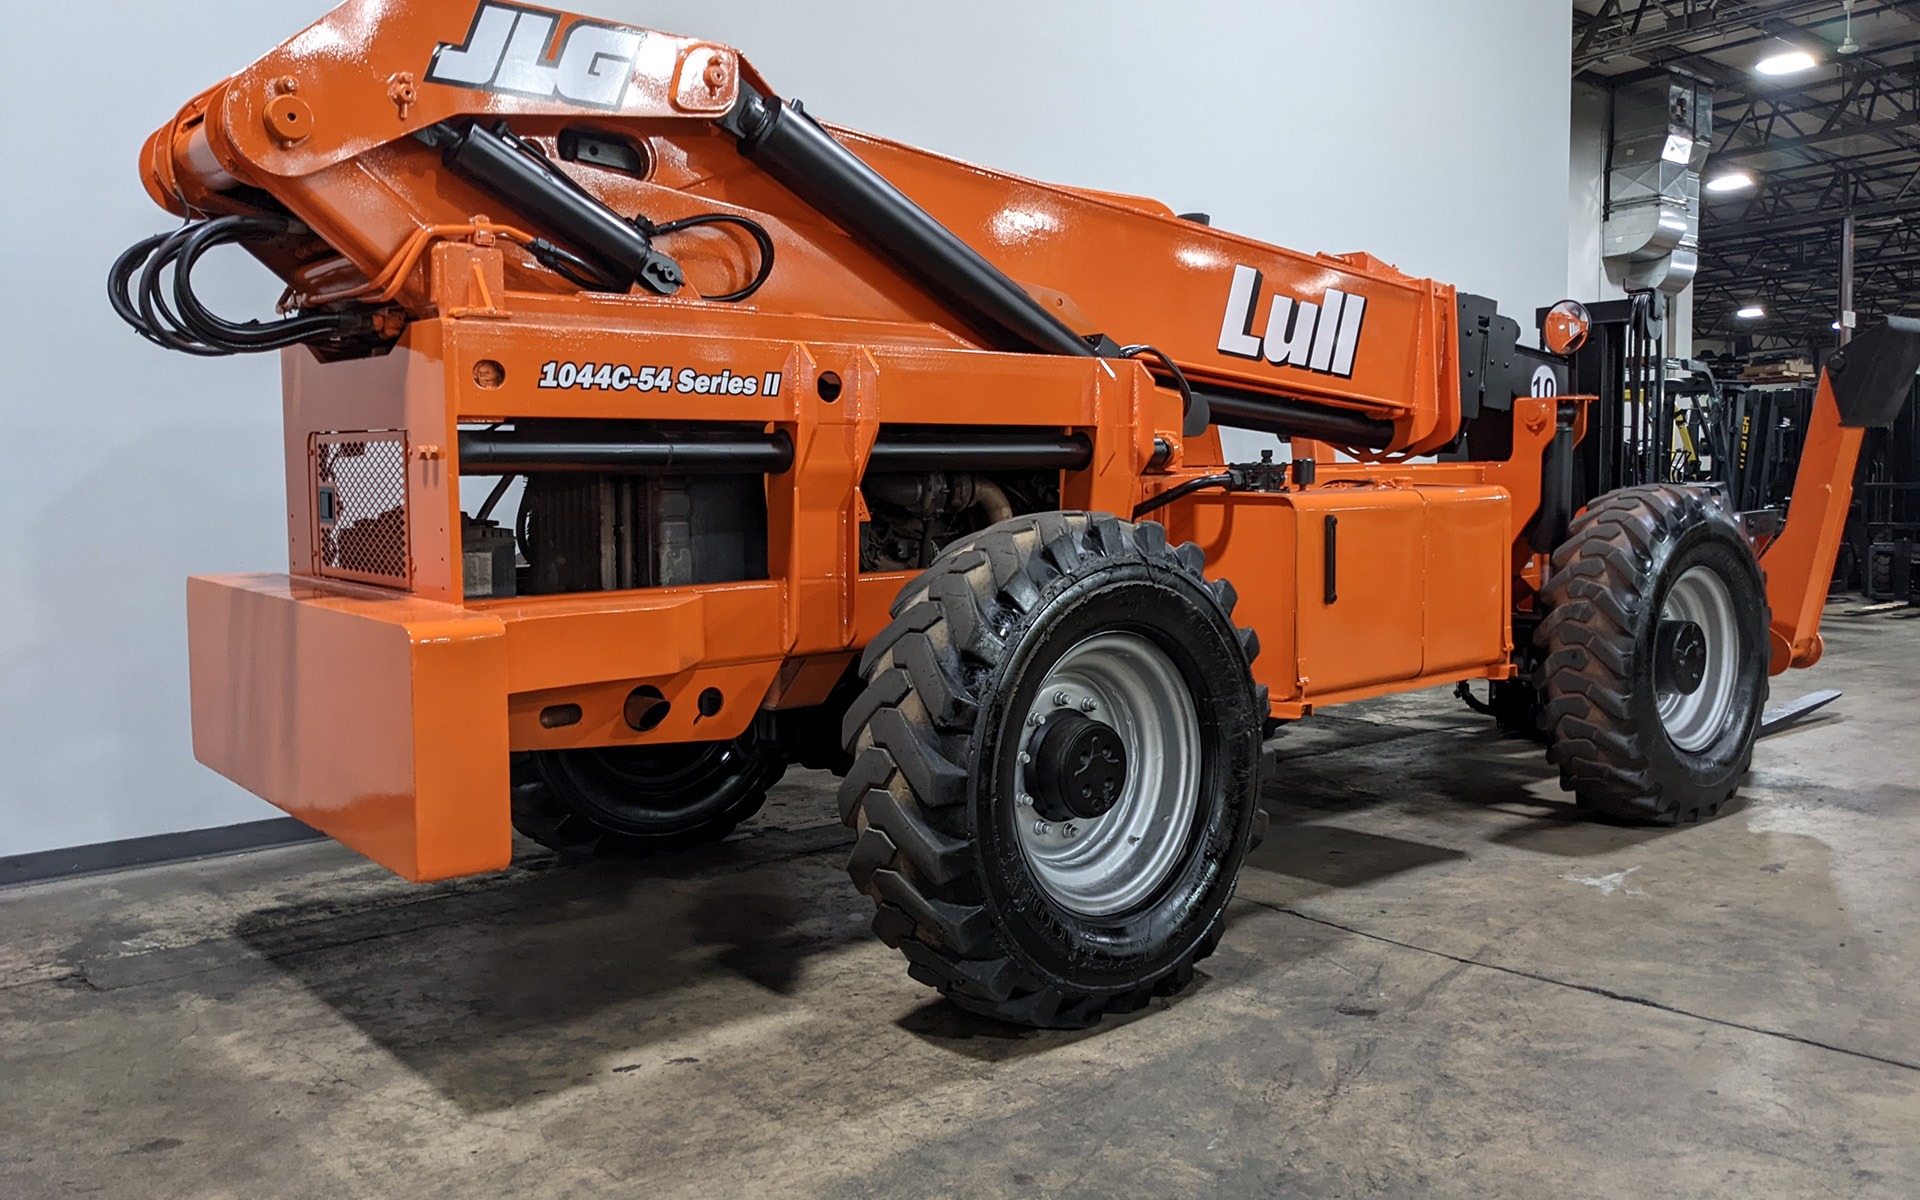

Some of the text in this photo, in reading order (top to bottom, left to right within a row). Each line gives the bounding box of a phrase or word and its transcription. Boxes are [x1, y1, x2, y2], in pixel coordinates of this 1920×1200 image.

[424, 0, 647, 111] JLG
[1217, 263, 1368, 380] Lull
[538, 361, 782, 396] 1044C-54 Series II
